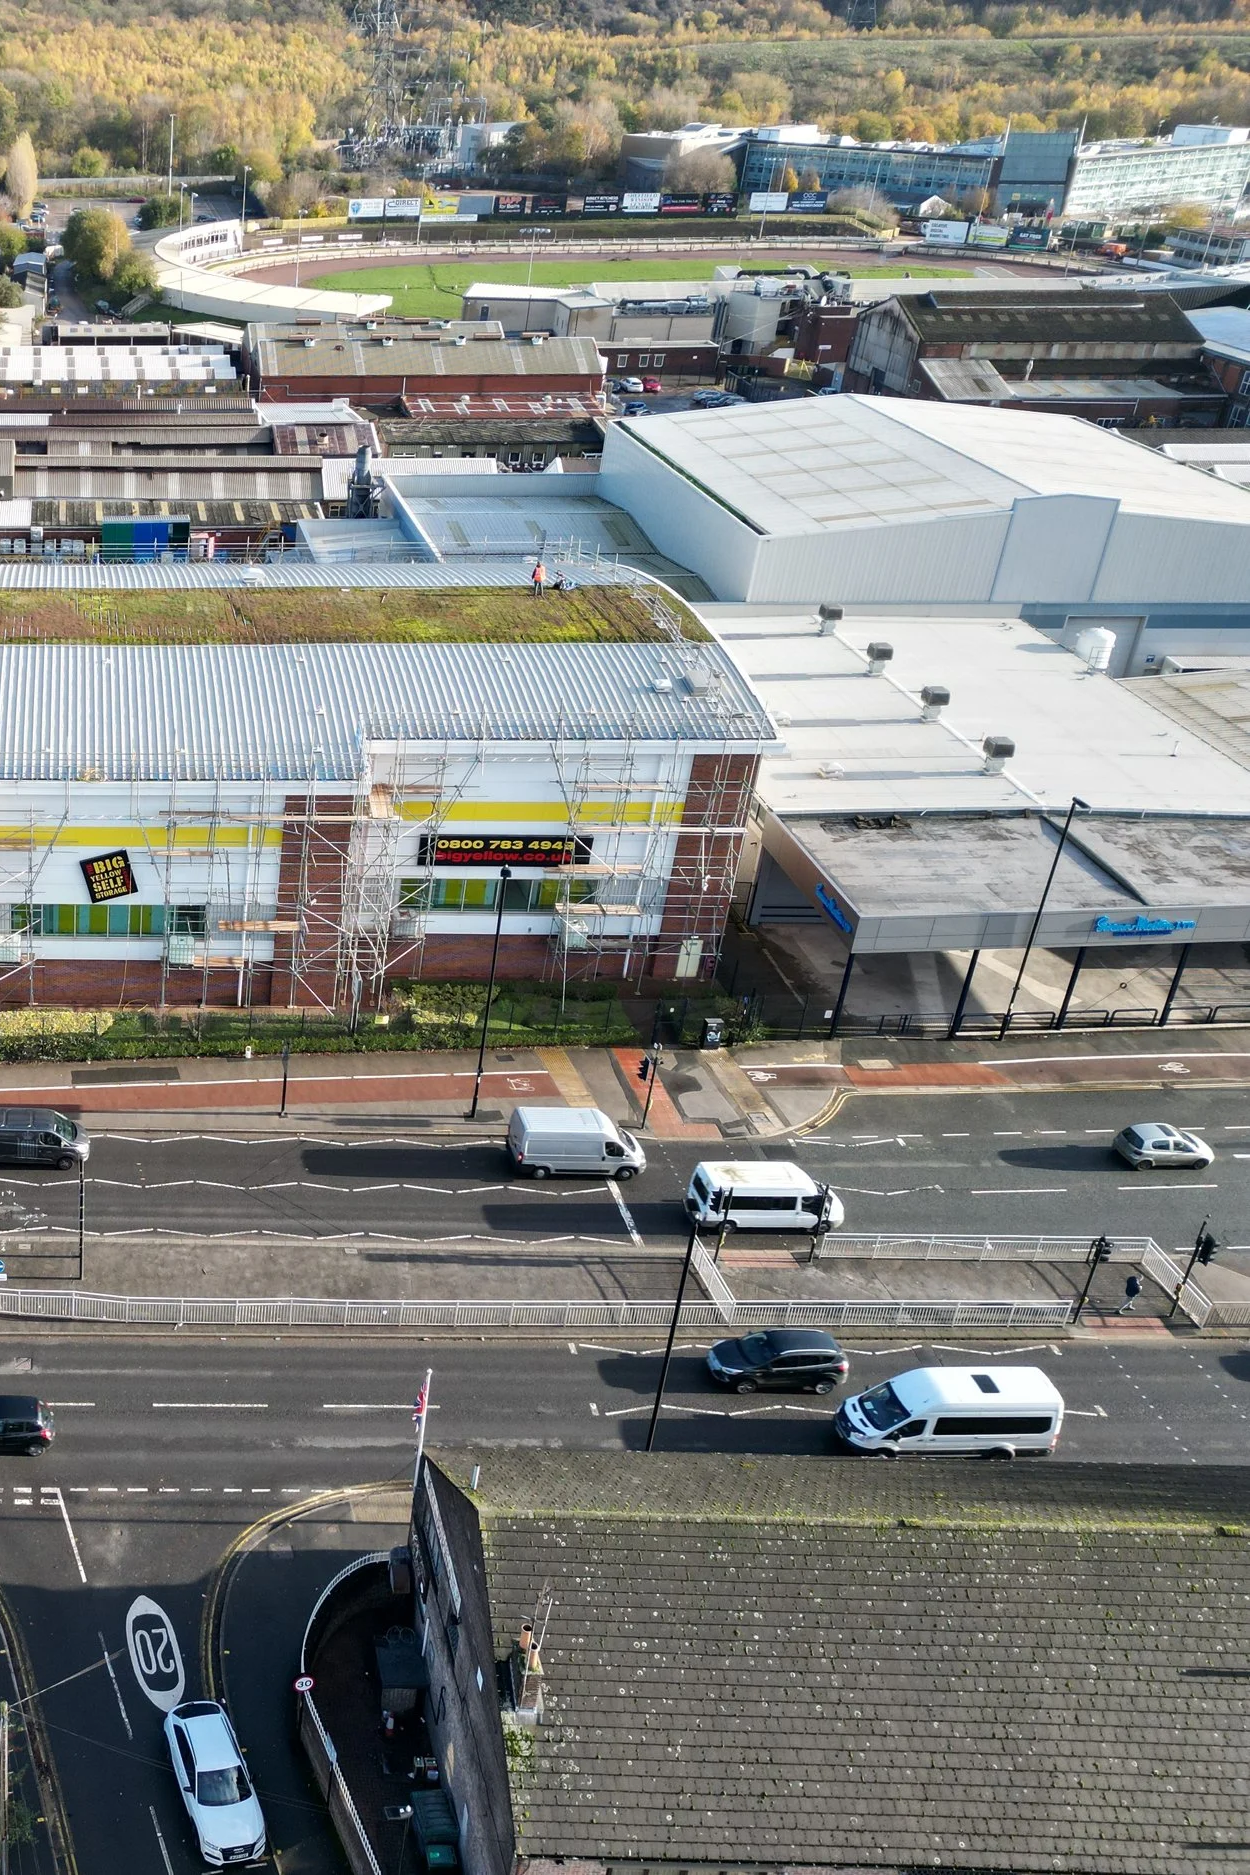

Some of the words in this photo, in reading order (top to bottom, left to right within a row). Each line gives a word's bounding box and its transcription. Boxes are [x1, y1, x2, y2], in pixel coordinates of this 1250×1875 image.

[437, 839, 484, 849] 0800
[489, 840, 523, 850] 783
[435, 851, 572, 862] bigyellow.co.uk
[93, 856, 125, 873] BIG
[90, 869, 121, 882] YELLOW
[93, 876, 123, 892] SELF
[95, 886, 127, 899] STORAGE
[135, 1628, 175, 1675] 20
[296, 1679, 311, 1688] 30
